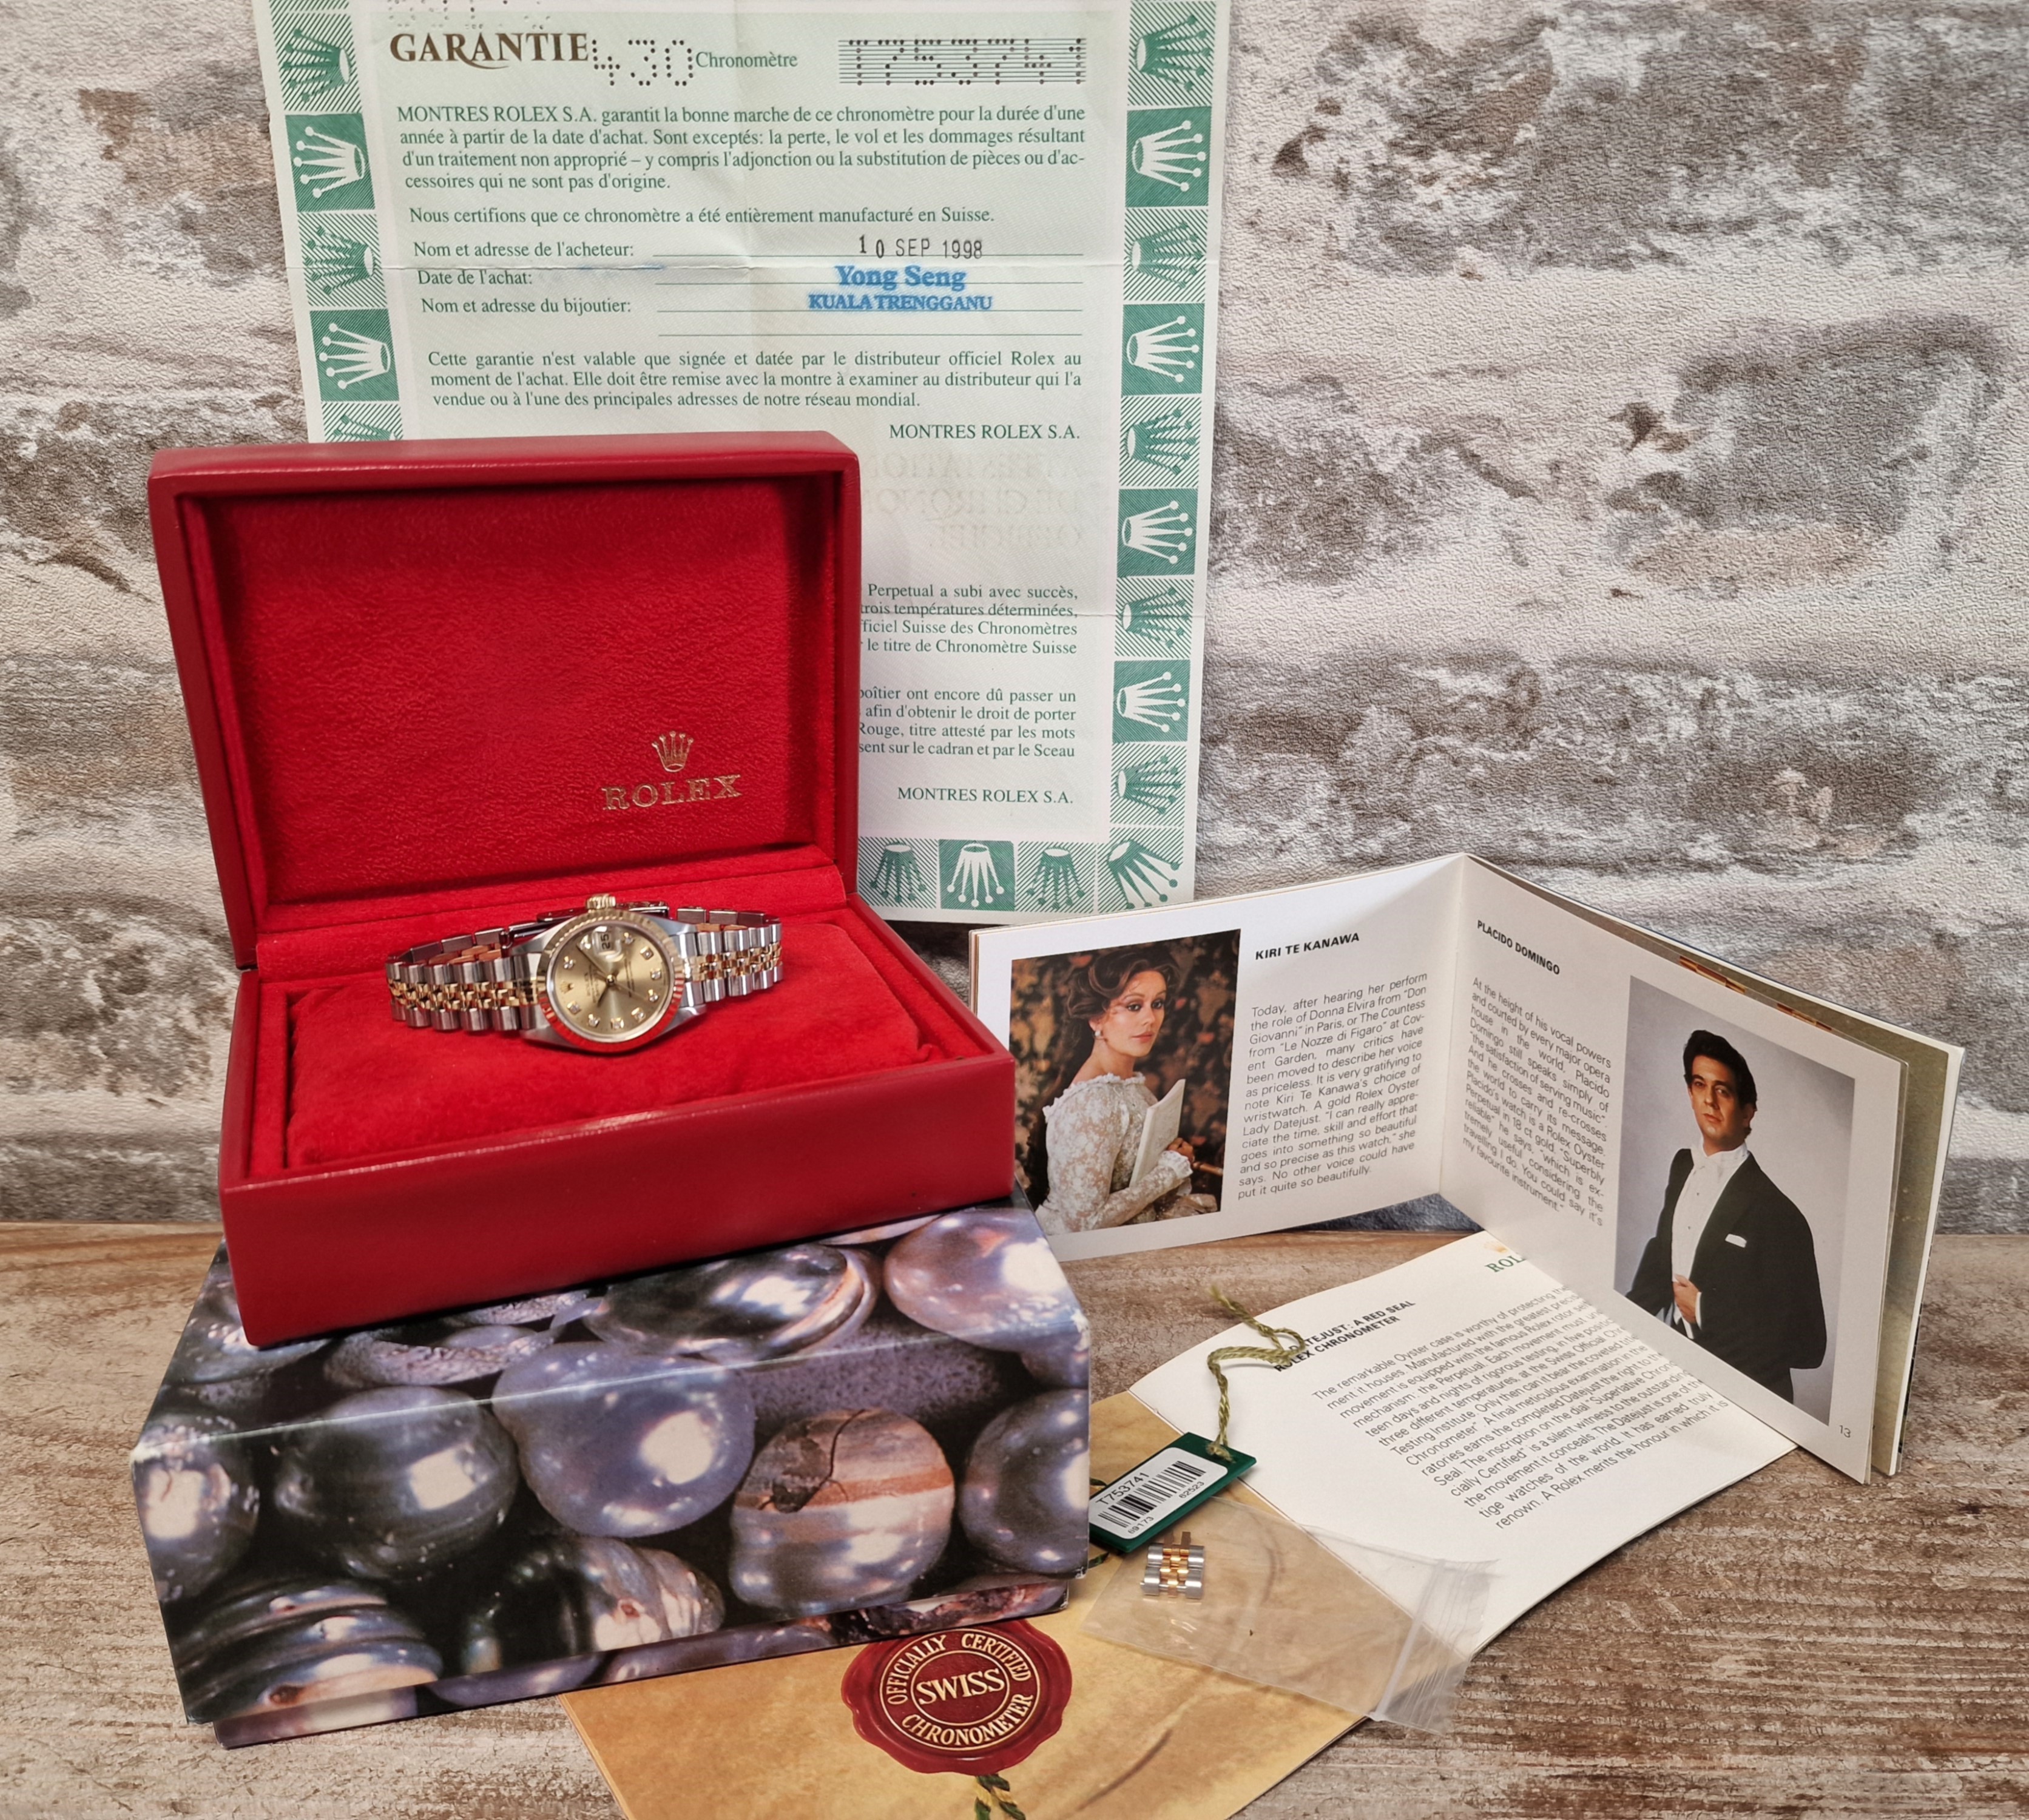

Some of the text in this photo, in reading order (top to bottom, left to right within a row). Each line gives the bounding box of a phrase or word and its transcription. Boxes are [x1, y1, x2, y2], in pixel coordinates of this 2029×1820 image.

[390, 32, 1082, 87] GARANTIE 430 Chronomètre T753741
[397, 104, 1085, 127] MONTRES ROLEX S.A. garantit la bonne marche de ce chronomètre pour la durée d'une
[405, 173, 670, 193] cessoires qui ne sont pas d'origine.
[410, 207, 994, 227] Nous certifions que ce chronomètre a été entièrement manufacturé en Suisse.
[414, 241, 633, 257] Nom et adresse de l'acheteur:
[417, 270, 532, 285] Date de l'achat:
[834, 265, 967, 292] Yong Seng
[421, 298, 630, 316] Nom et adresse du bijoutier:
[809, 294, 993, 311] KUALA TRENGGANU
[433, 391, 920, 410] vendue ou à l'une des principales adresses de notre réseau mondial.
[868, 584, 1078, 601] Perpetual a subi avec succès,
[868, 638, 1076, 654] le titre de Chronomètre Suisse
[601, 774, 743, 811] ROLEX
[898, 787, 1073, 803] MONTRES ROLEX S.A.
[1255, 932, 1360, 960] KIRI TE KANAWA
[1477, 920, 1560, 975] PLACIDO DOMINGO
[1252, 973, 1427, 1017] Today, after hearing her perform
[1472, 993, 1610, 1084] and courted by every major opera
[1473, 977, 1611, 1068] At the height of his vocal powers
[1247, 1040, 1423, 1084] been moved to describe her voice
[1238, 1165, 1372, 1201] put it quite so beautifully.
[1289, 1324, 1354, 1351] DTEJUST:
[1362, 1310, 1386, 1322] RED
[1385, 1301, 1416, 1313] SEAL
[1315, 1315, 1401, 1352] CHRONOMETER
[1840, 1425, 1851, 1438] 13
[1479, 1501, 1505, 1518] tige
[1505, 1473, 1554, 1502] watches
[1555, 1463, 1568, 1474] of
[1568, 1454, 1589, 1466] the
[1589, 1437, 1624, 1456] world.
[1632, 1421, 1655, 1434] has
[1655, 1403, 1690, 1423] earned
[1688, 1391, 1713, 1406] truly
[1496, 1500, 1544, 1529] renown.
[1541, 1491, 1556, 1501] A
[1550, 1474, 1585, 1494] Rolex
[1583, 1455, 1618, 1478] merits
[1615, 1446, 1636, 1460] the
[1632, 1431, 1670, 1451] honour
[1665, 1425, 1681, 1434] in
[1679, 1409, 1712, 1428] which
[1095, 1472, 1149, 1505] T753741
[1127, 1516, 1154, 1534] 69173
[886, 1633, 1031, 1705] OFFICIALLY CERTIFIED
[916, 1668, 1005, 1705] SWISS
[902, 1693, 1034, 1745] CHRONOMETER
